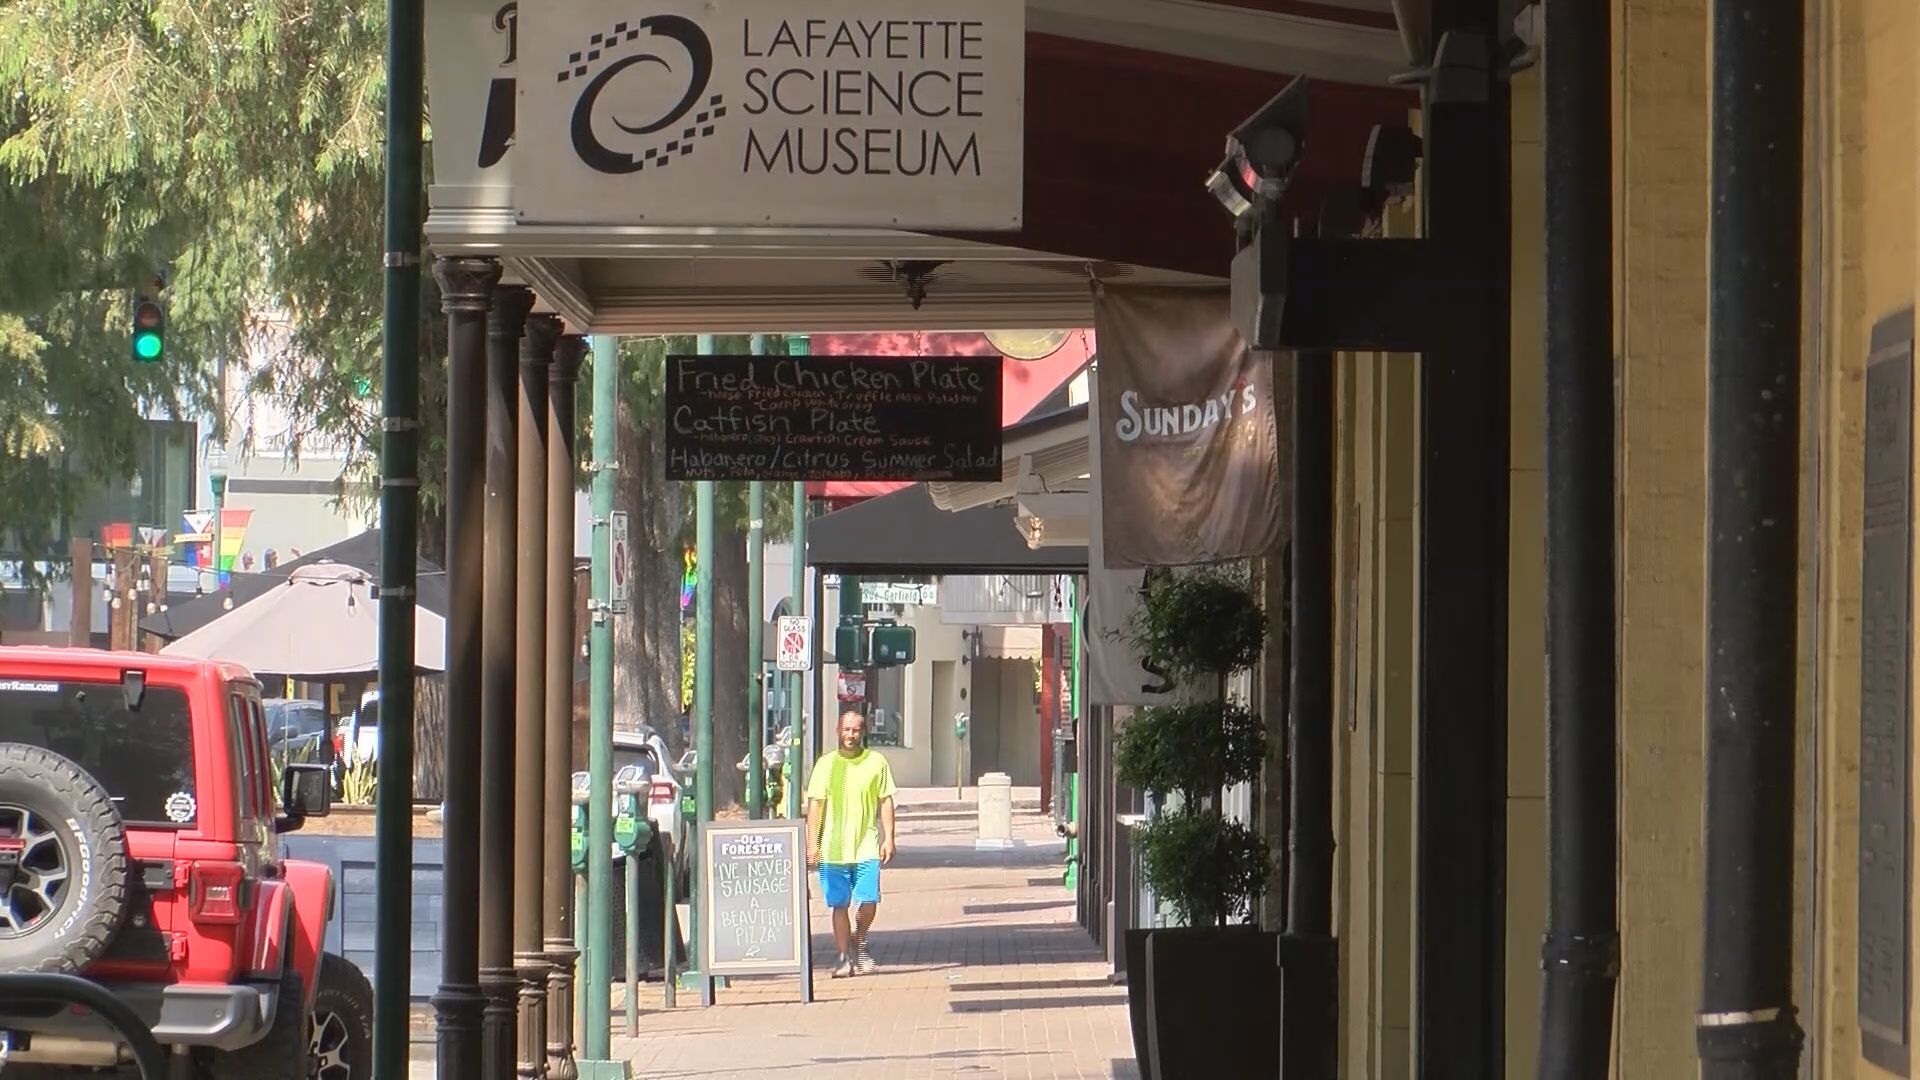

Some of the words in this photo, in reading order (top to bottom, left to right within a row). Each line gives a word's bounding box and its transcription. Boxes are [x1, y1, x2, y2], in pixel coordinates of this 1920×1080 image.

[744, 19, 983, 60] LAFAYETTE
[742, 68, 984, 118] SCIENCE
[743, 128, 982, 177] MUSEUM
[678, 359, 762, 393] Fried
[773, 359, 901, 391] Chicken
[909, 360, 983, 392] Plate
[673, 404, 790, 434] Catfish
[811, 407, 880, 433] Plate
[861, 450, 937, 470] Summer
[943, 443, 999, 470] Salad
[884, 589, 918, 602] Garfield
[721, 842, 784, 856] FORESTER
[720, 877, 790, 897] SAUSAGE
[750, 896, 760, 910] A
[721, 907, 793, 929] BEAUTIFUL
